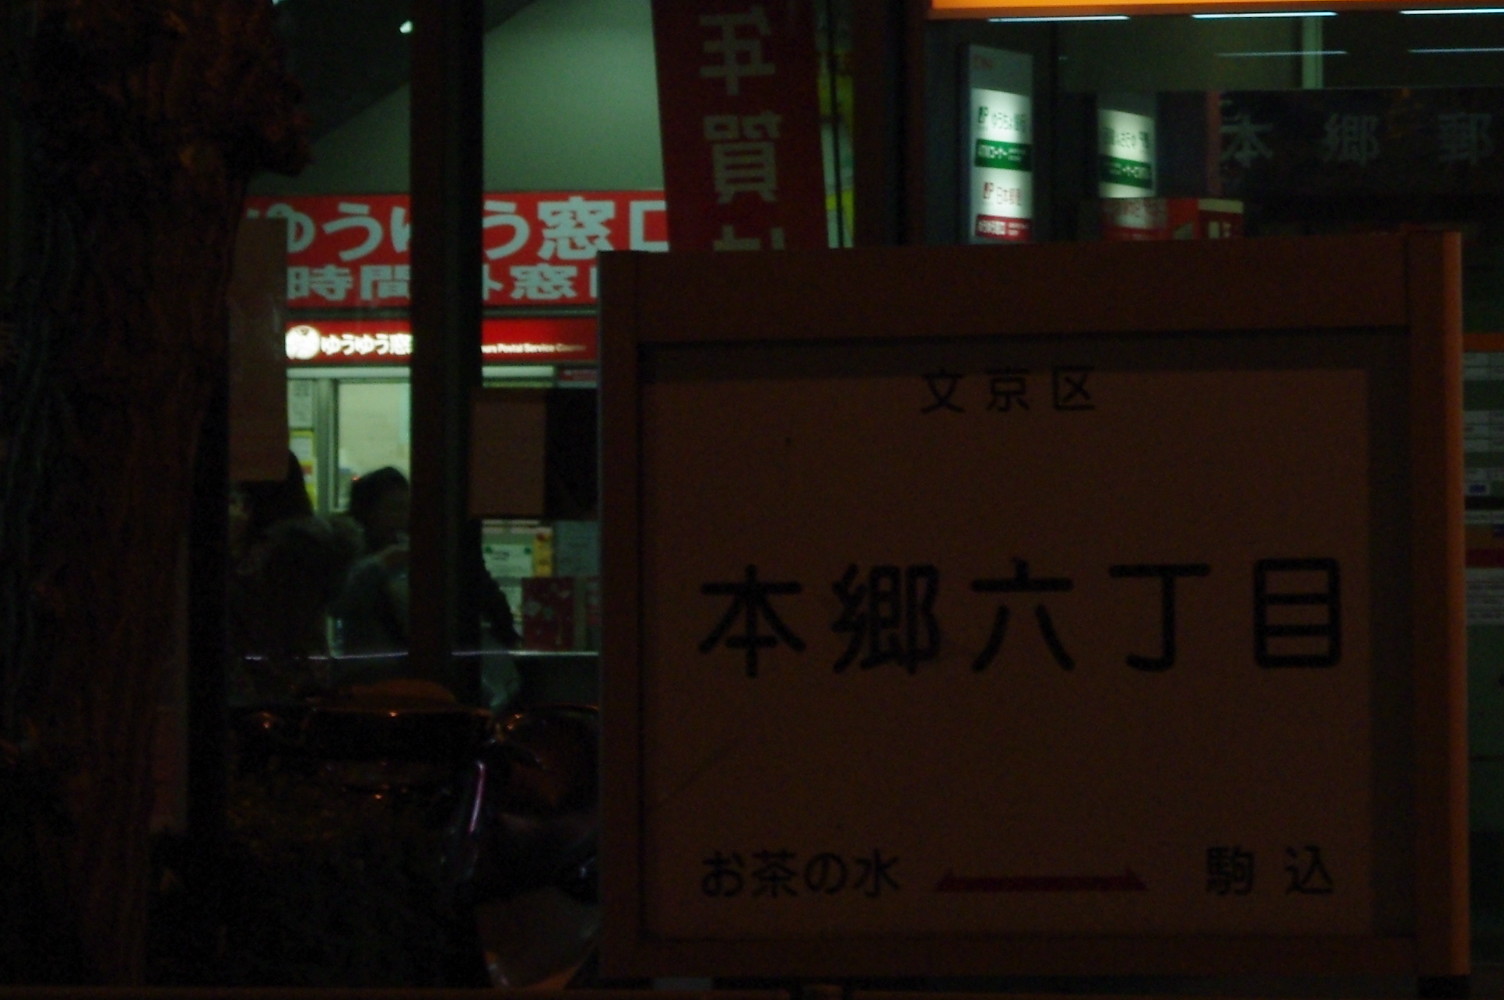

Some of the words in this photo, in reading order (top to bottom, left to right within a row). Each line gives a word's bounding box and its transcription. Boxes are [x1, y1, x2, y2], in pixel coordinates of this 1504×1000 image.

[921, 366, 1097, 414] 文京区
[699, 558, 1342, 678] 本郷六丁目
[701, 849, 901, 899] お茶の水
[1205, 845, 1335, 897] 駒込
